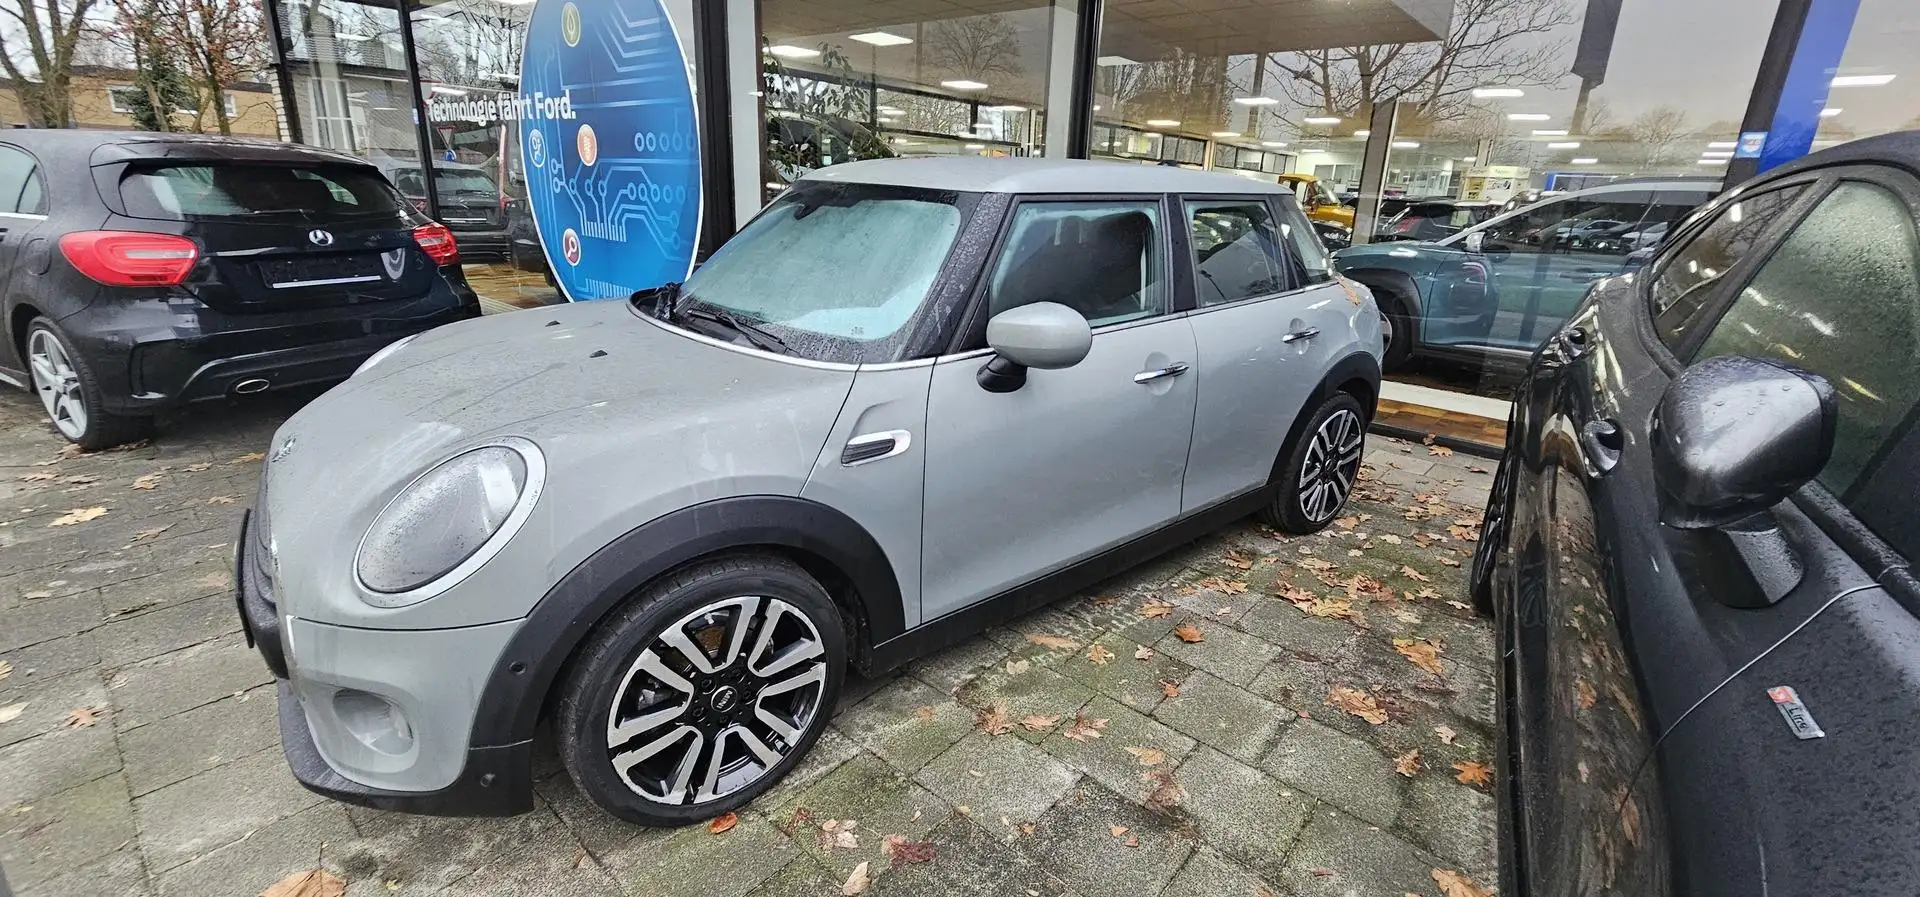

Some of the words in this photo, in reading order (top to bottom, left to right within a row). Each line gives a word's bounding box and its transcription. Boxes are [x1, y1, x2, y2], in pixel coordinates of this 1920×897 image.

[427, 94, 497, 127] Technologie
[497, 92, 534, 121] fährt
[534, 88, 577, 120] Ford.
[716, 690, 733, 709] MINI
[1788, 707, 1809, 729] Line
